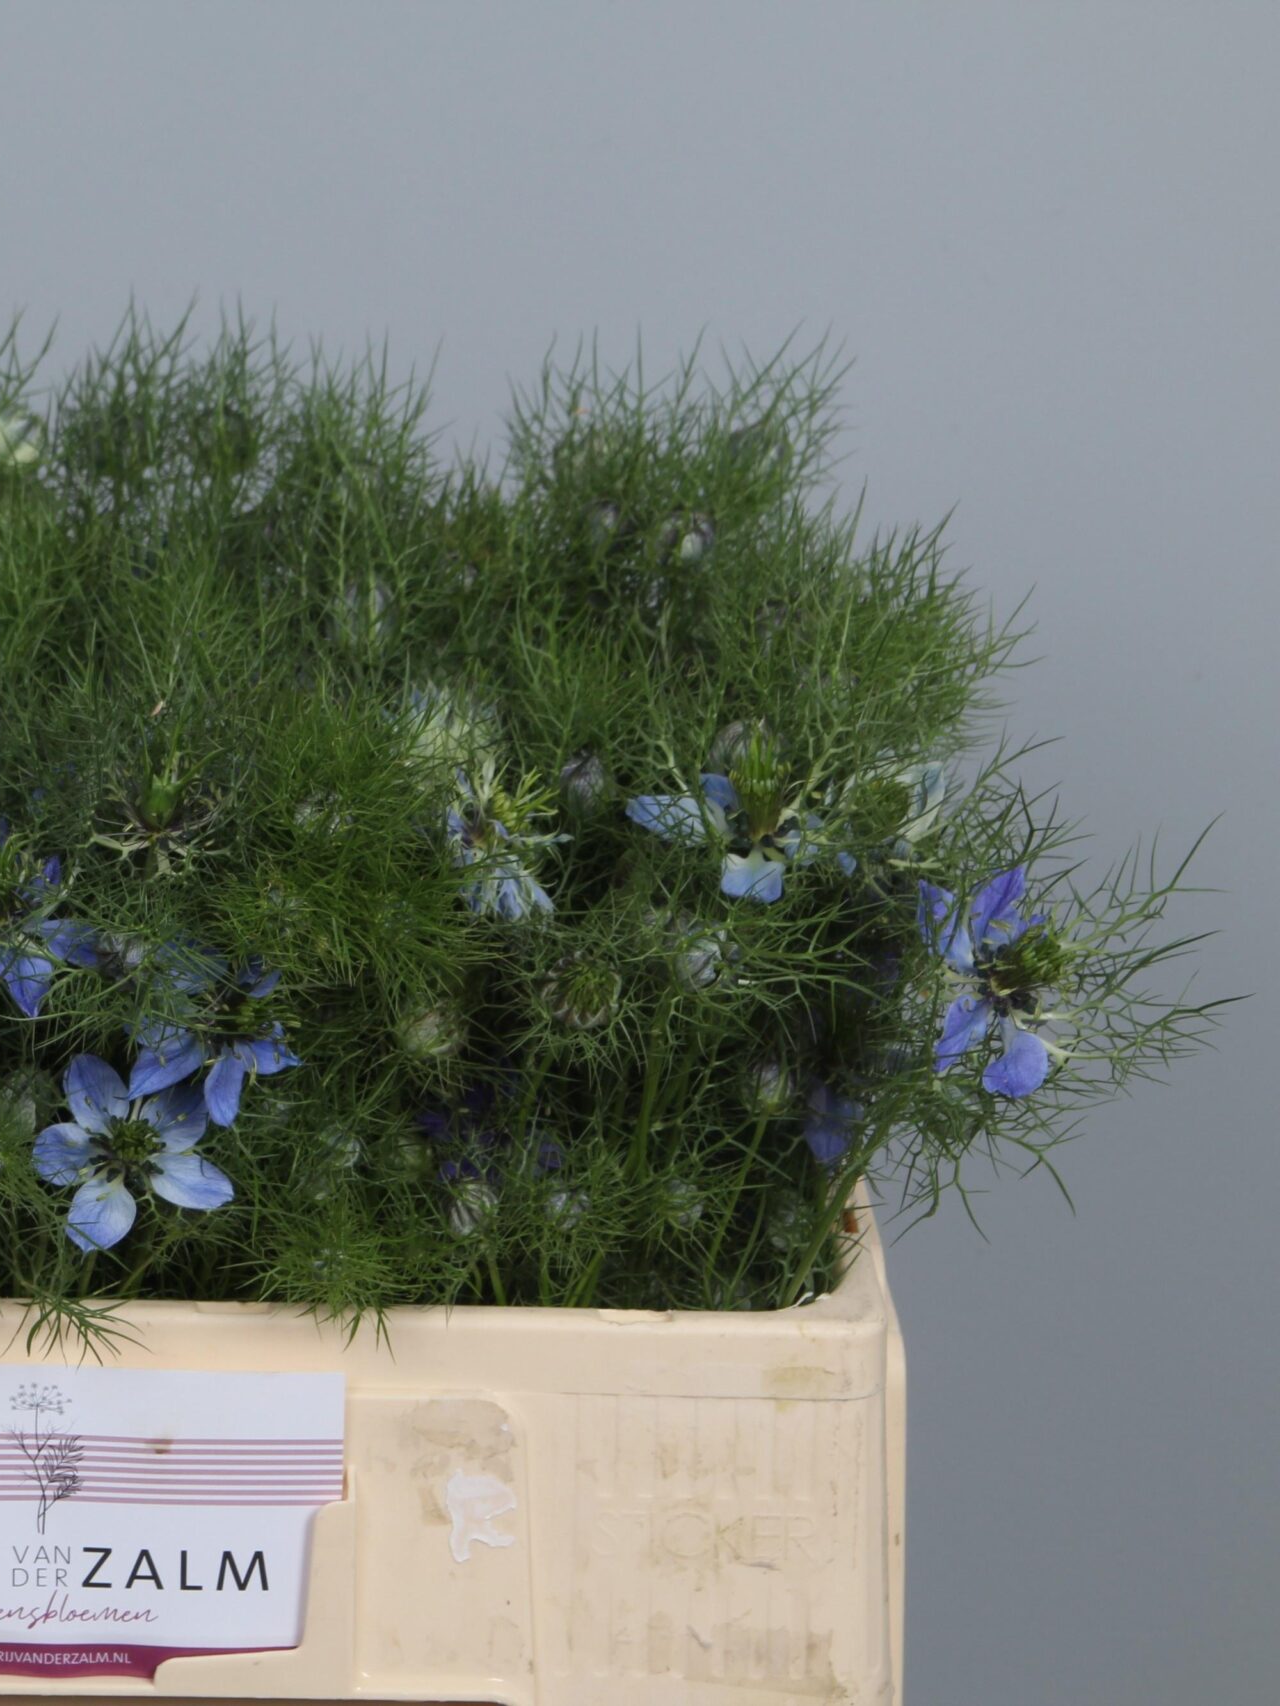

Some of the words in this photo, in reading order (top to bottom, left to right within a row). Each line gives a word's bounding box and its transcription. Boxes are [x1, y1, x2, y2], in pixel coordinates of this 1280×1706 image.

[12, 1545, 72, 1565] VAN
[12, 1567, 69, 1588] DER
[81, 1546, 270, 1591] ZALM
